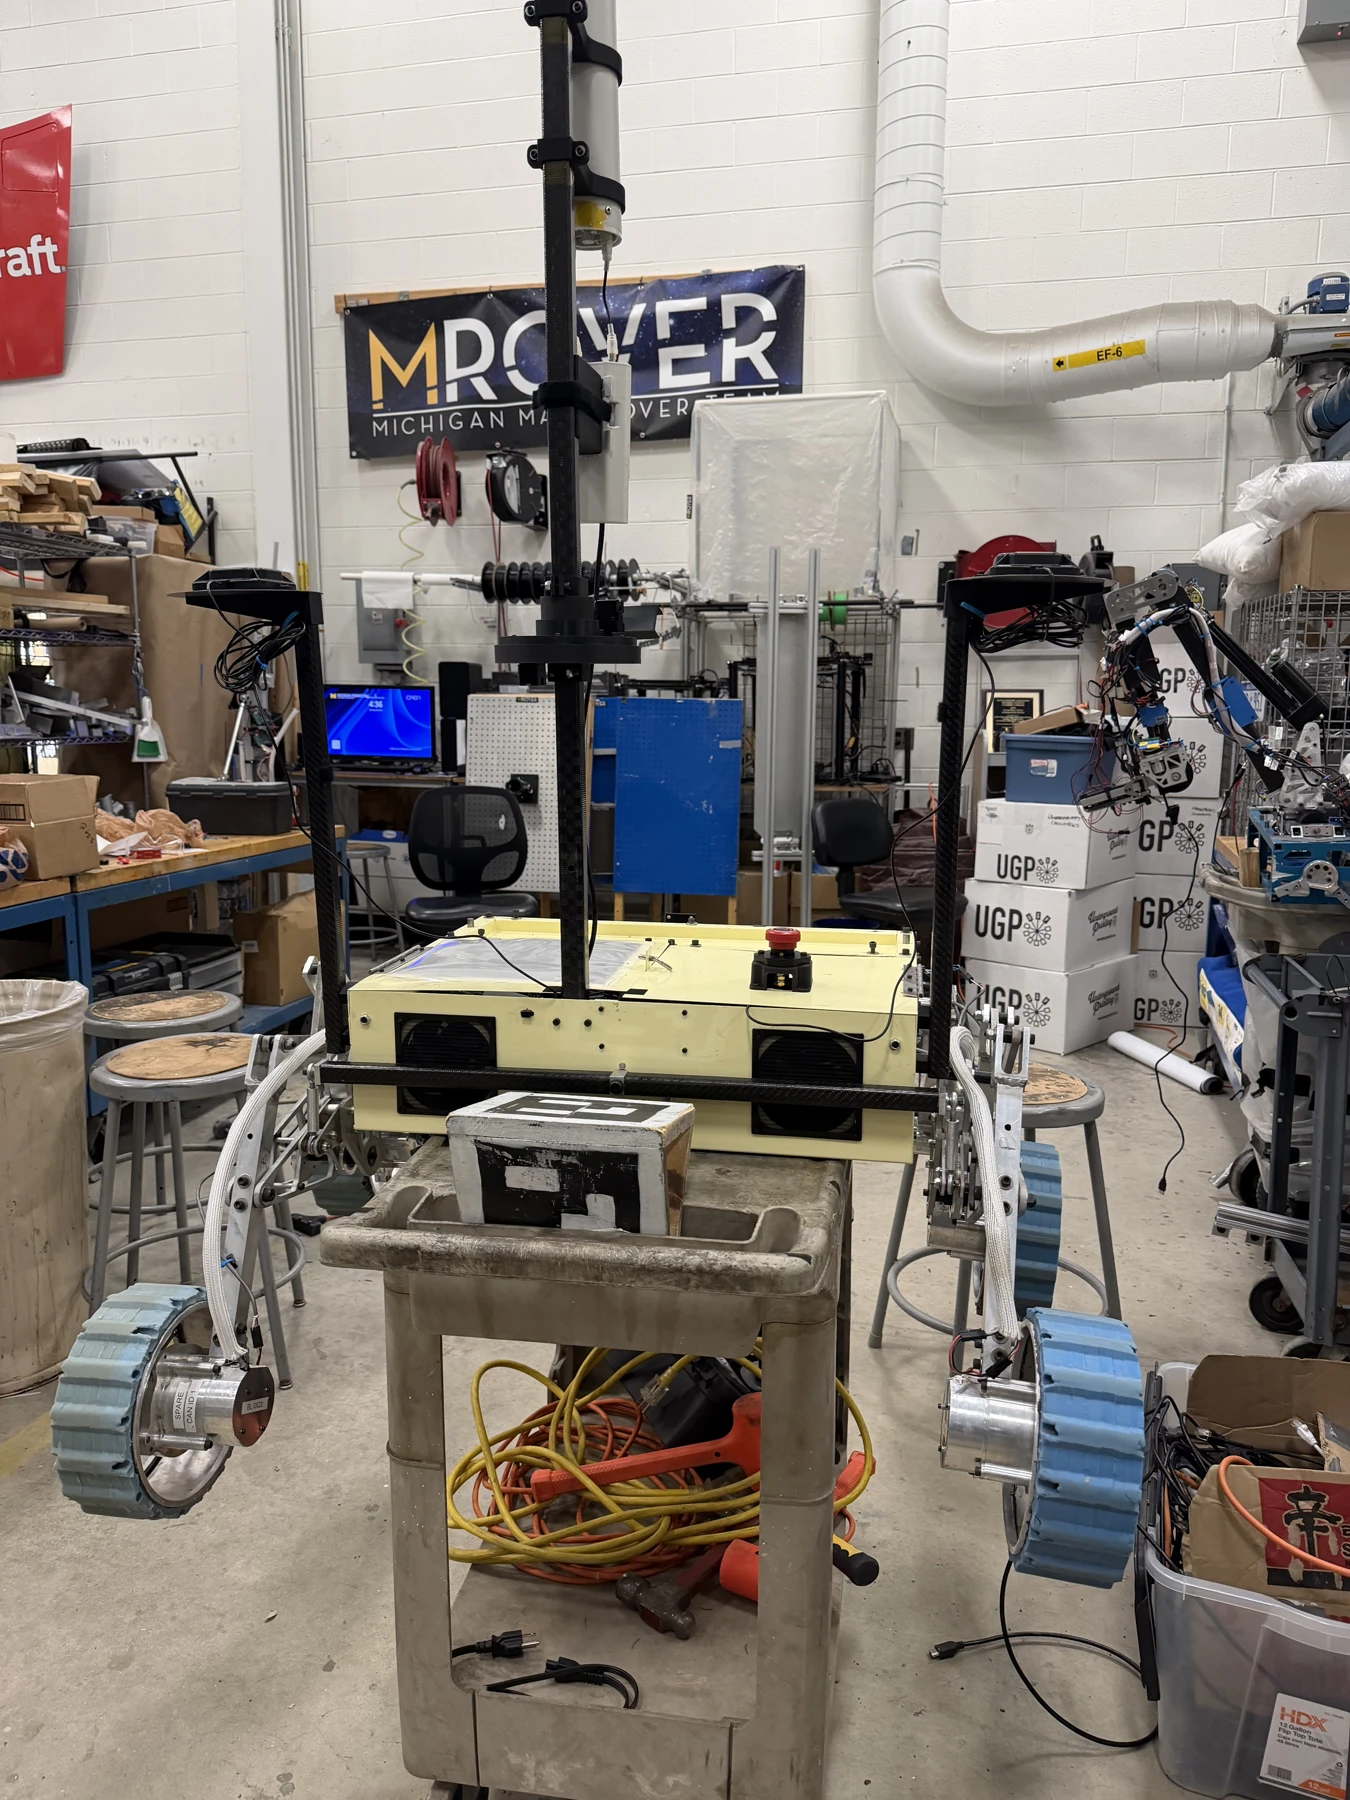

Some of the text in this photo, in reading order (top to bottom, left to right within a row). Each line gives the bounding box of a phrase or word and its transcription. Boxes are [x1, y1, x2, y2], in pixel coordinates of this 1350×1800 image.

[1096, 346, 1123, 361] EF-6
[372, 398, 689, 437] MICHIGAN MA VER
[1160, 668, 1186, 693] GP
[1138, 819, 1174, 852] GP
[997, 853, 1036, 881] UGP
[974, 904, 1022, 942] UGP
[1139, 896, 1174, 929] GP
[1134, 997, 1160, 1021] GP
[174, 1392, 185, 1420] SPARE
[188, 1396, 195, 1406] ID
[186, 1406, 194, 1424] CAN
[1280, 1706, 1328, 1732] HDX
[1289, 1724, 1312, 1735] Gallon
[1278, 1727, 1323, 1744] Flip Top Tote
